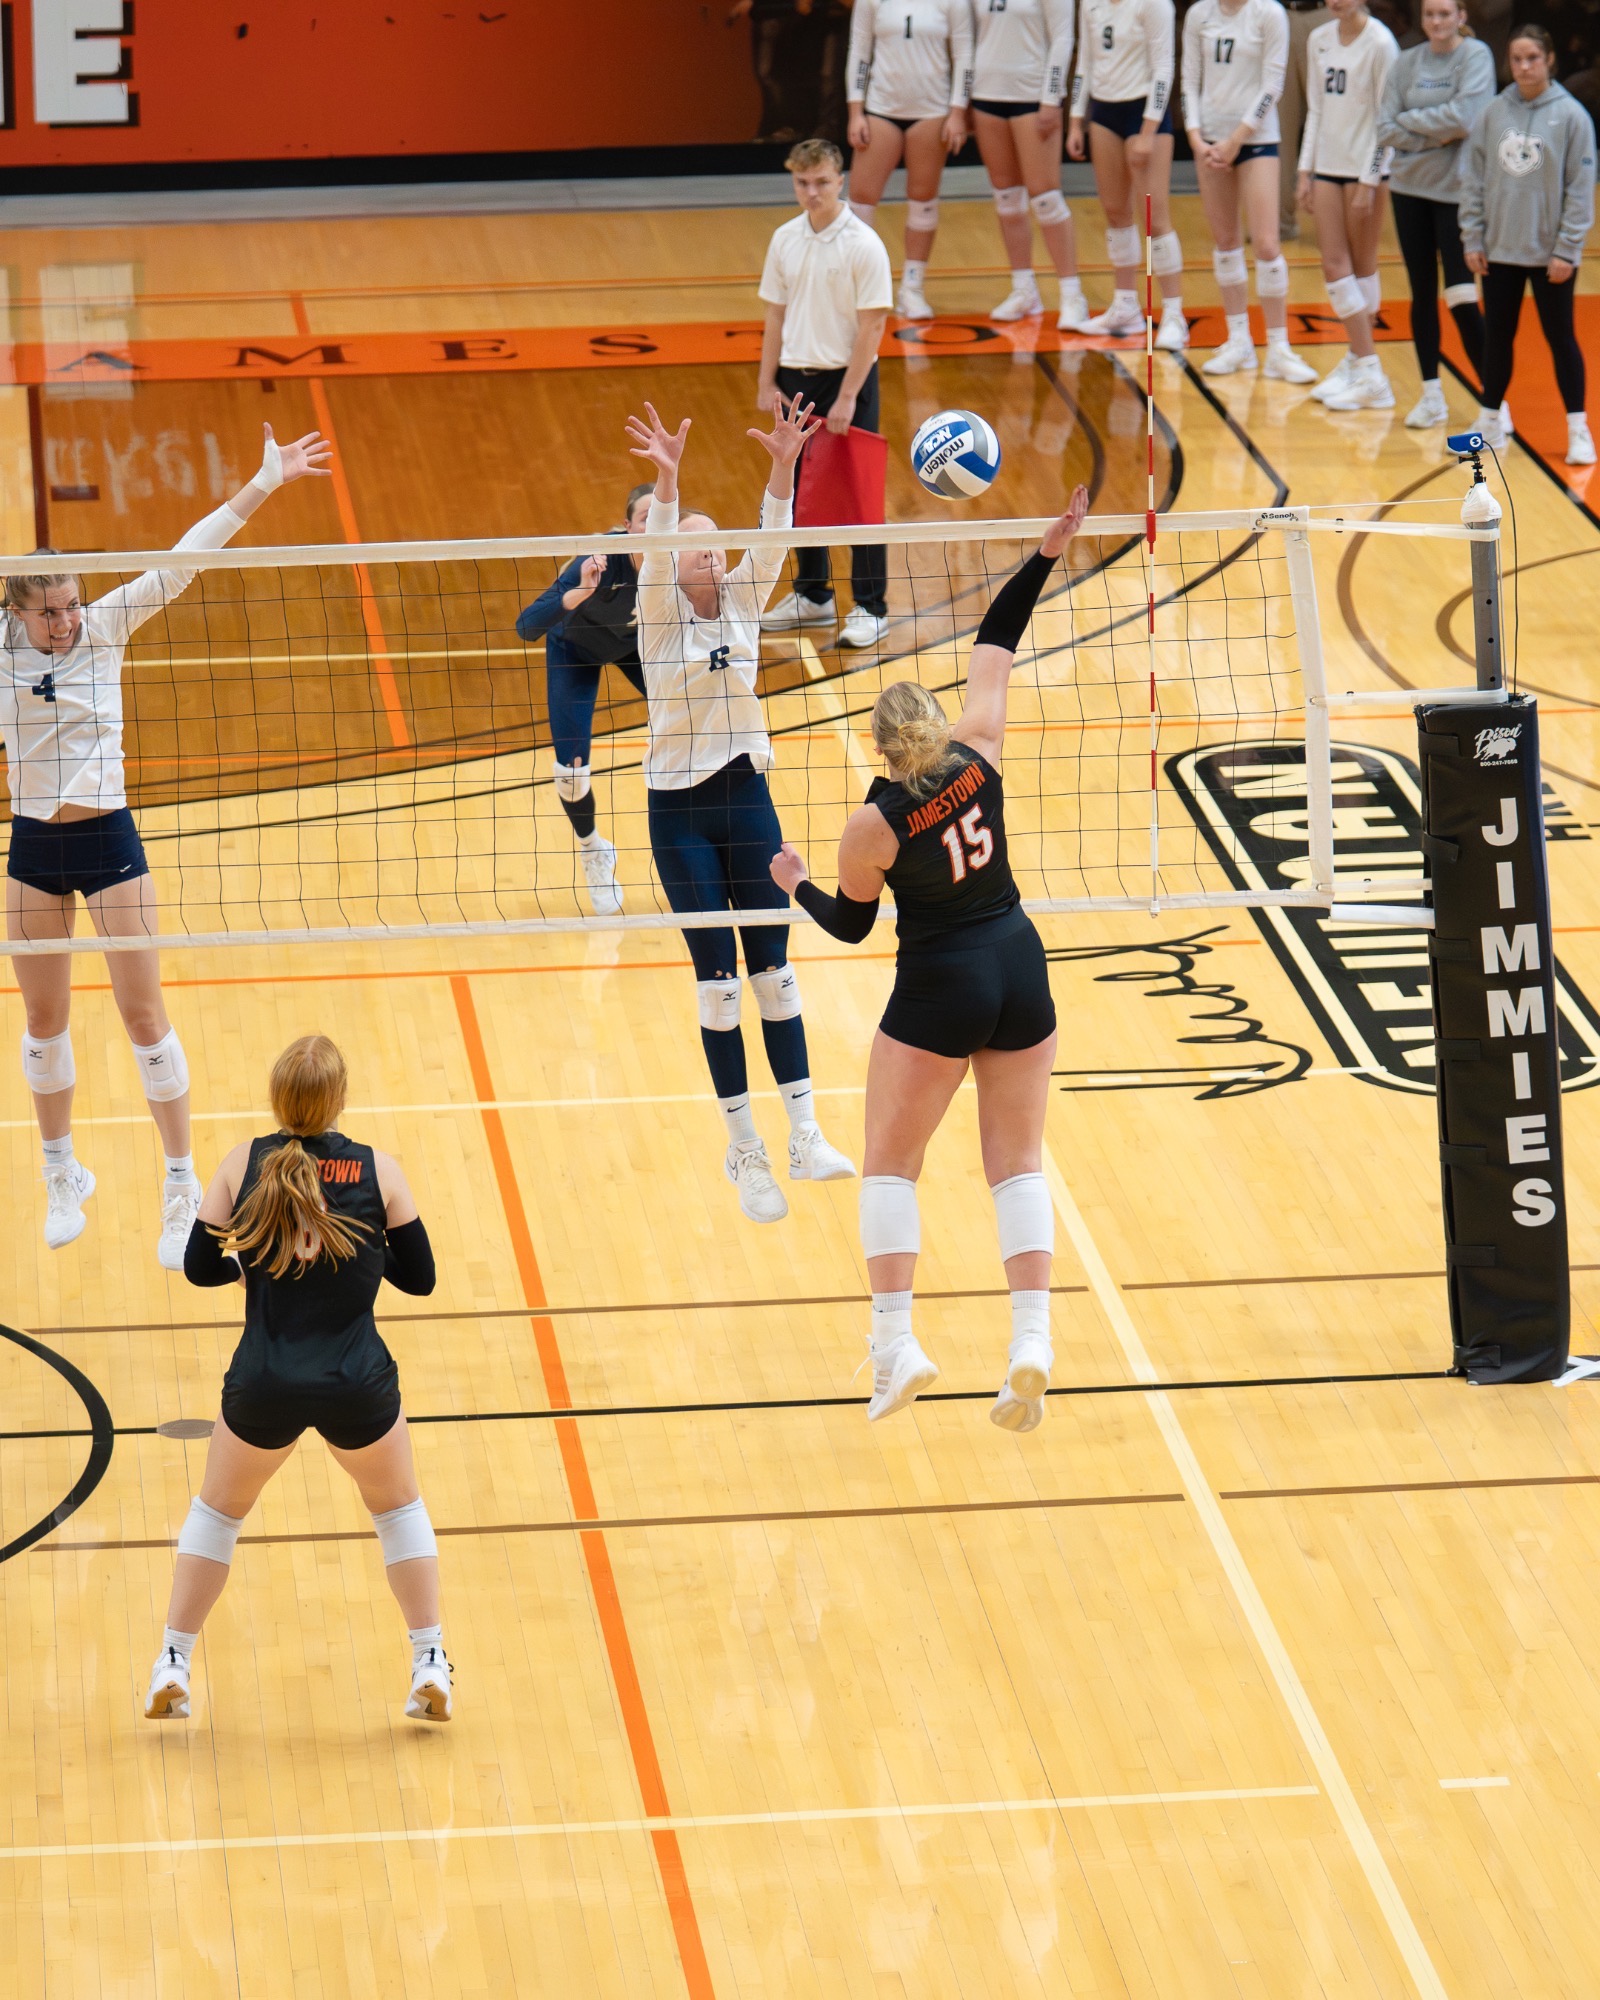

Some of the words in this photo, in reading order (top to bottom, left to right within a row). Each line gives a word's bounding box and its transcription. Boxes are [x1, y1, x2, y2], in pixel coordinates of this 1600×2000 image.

[904, 15, 912, 39] 1
[1103, 25, 1114, 49] 9
[1214, 37, 1235, 63] 17
[1325, 66, 1347, 95] 20
[924, 438, 964, 475] molten
[32, 673, 56, 702] 4
[1473, 725, 1522, 759] Bison
[906, 761, 986, 838] JAMESTOWN
[941, 802, 994, 884] 15
[1480, 797, 1556, 1227] JIMMIES
